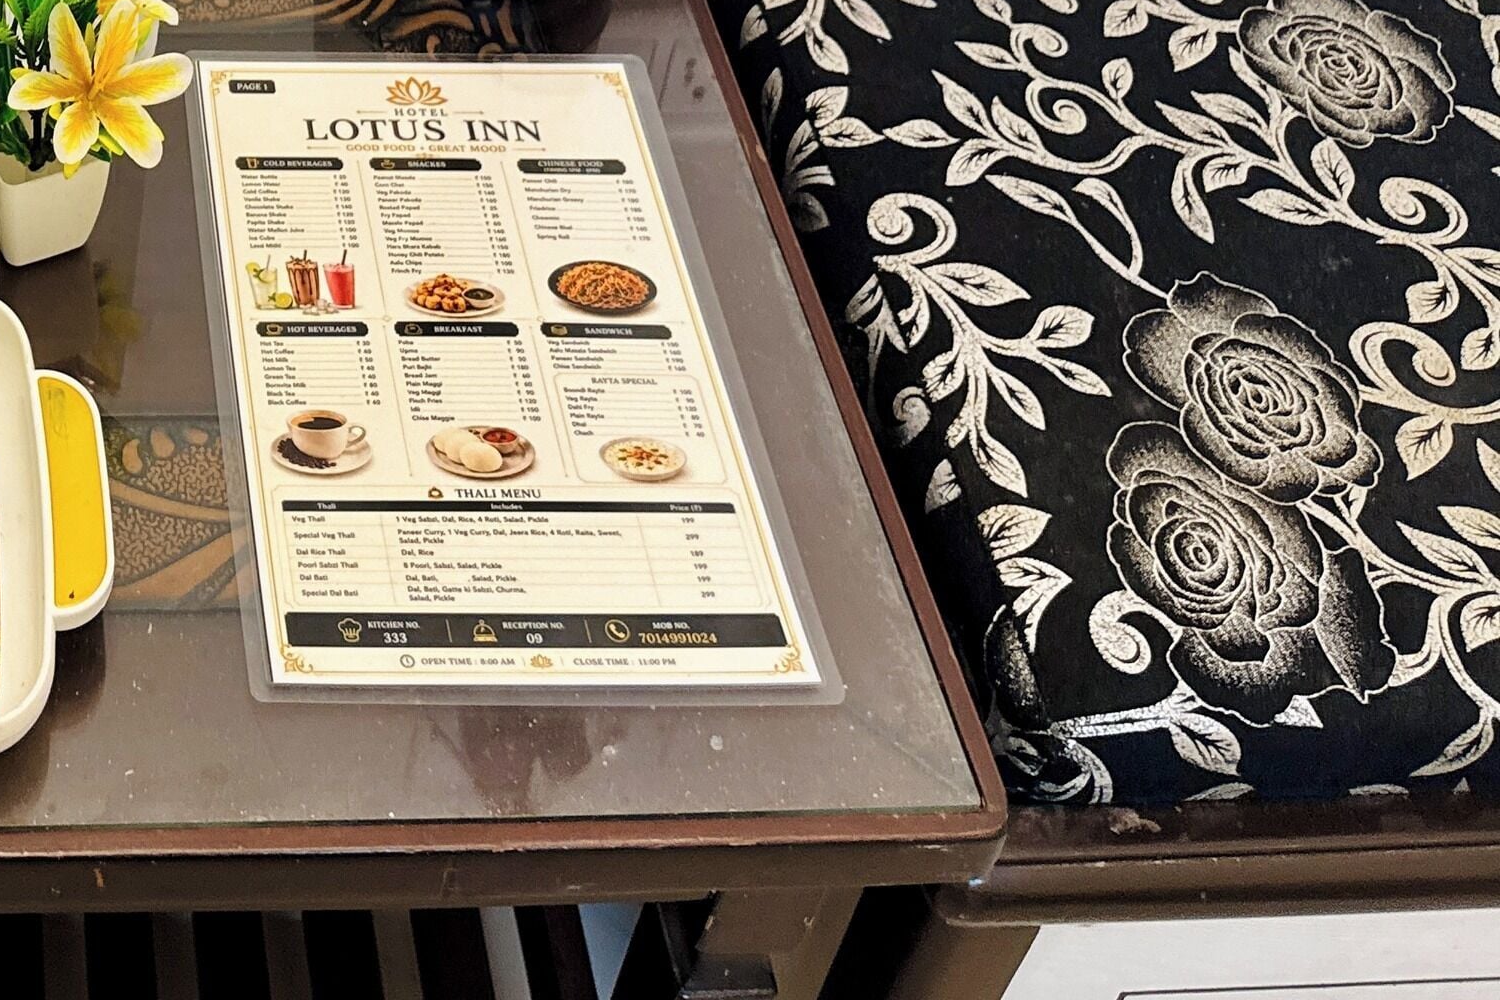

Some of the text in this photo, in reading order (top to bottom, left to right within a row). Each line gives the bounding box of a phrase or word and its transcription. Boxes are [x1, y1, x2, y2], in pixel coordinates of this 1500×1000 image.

[237, 83, 261, 91] PAGE
[395, 108, 448, 116] HOTEL
[303, 118, 541, 142] LOTUS INN
[346, 144, 379, 152] GOOD
[383, 144, 415, 152] FOOD
[470, 145, 507, 153] MOOD
[578, 160, 604, 168] FOOD
[584, 327, 633, 336] SANDWICH
[455, 489, 541, 498] THALI MENU
[294, 532, 320, 540] Special
[302, 589, 328, 597] Special
[367, 621, 420, 629] KITCHEN NO.
[502, 621, 564, 630] RECEPTION NO.
[652, 622, 691, 630] MOB NO.
[384, 633, 408, 644] 333
[526, 633, 543, 644] 09
[638, 633, 718, 644] 7014991024
[450, 658, 472, 666] TIME
[480, 658, 498, 666] 8:00
[500, 658, 516, 666] AM
[573, 658, 604, 666] CLOSE
[607, 658, 630, 666] TIME
[638, 658, 660, 666] 11:00
[662, 658, 676, 666] PM
